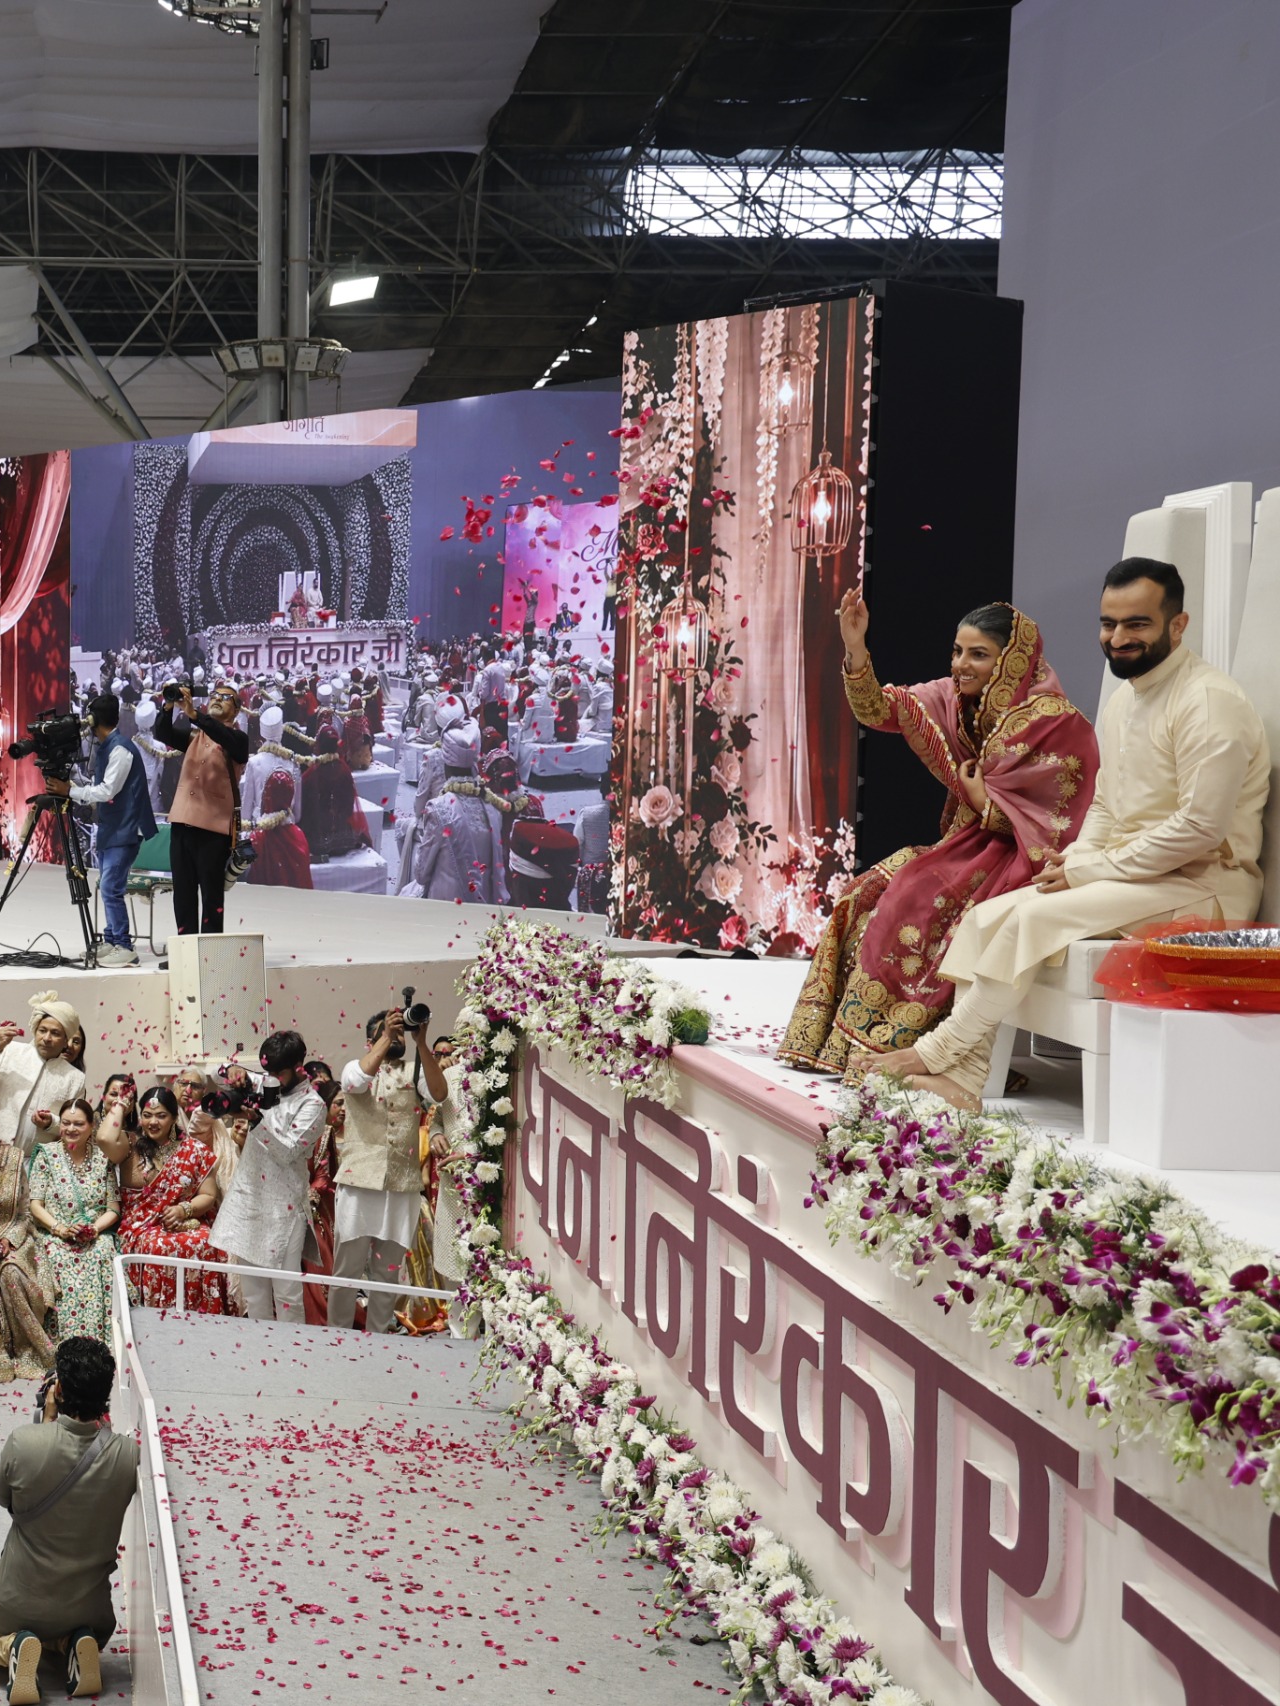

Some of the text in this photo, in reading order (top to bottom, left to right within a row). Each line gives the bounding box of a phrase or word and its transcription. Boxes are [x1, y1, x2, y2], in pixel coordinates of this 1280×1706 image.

[217, 633, 403, 669] धन निरंकार जी
[521, 1040, 615, 1290] धन
[617, 1097, 1086, 1706] निरंकार
